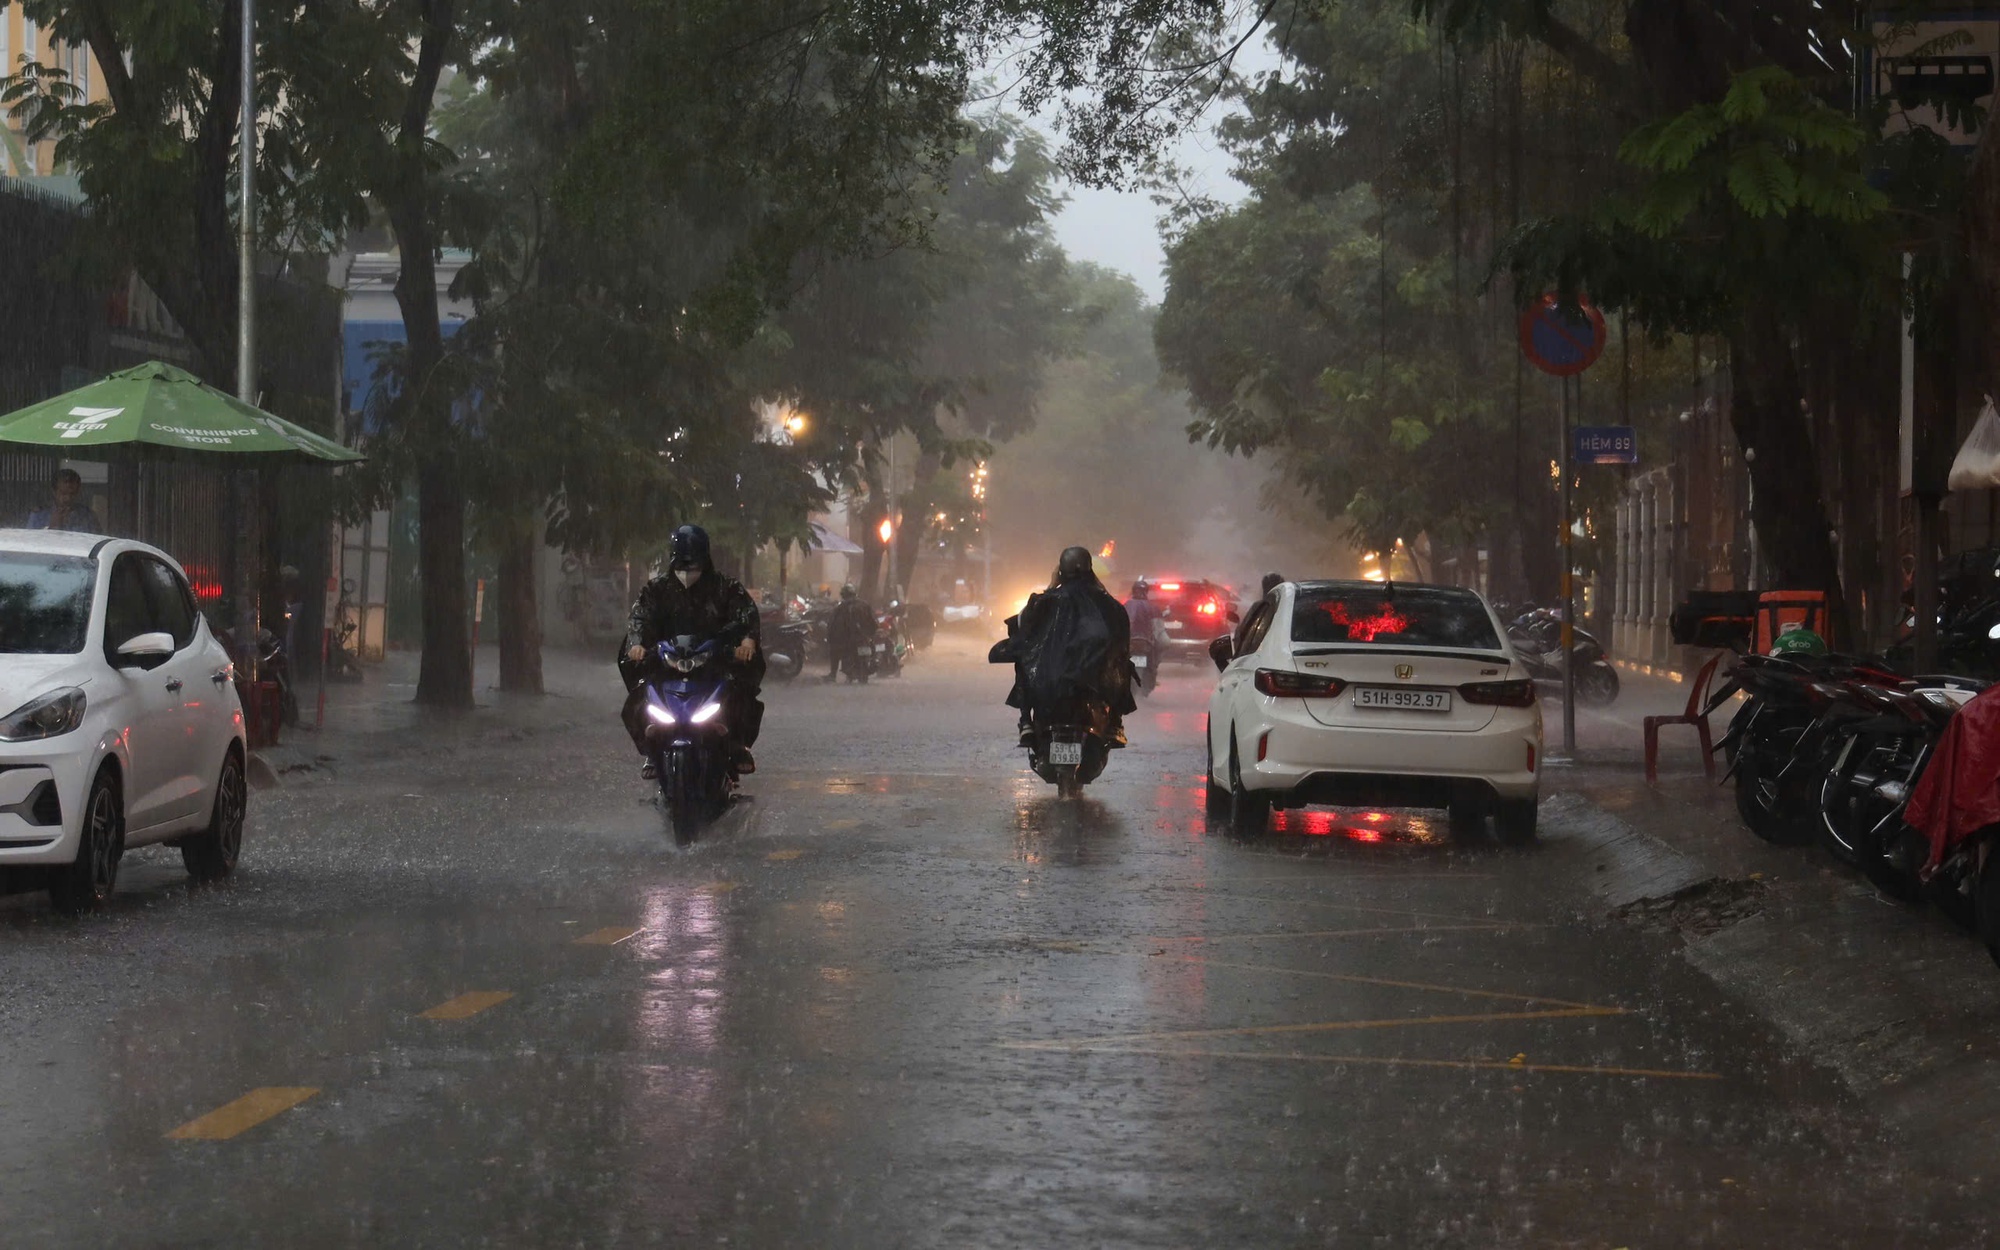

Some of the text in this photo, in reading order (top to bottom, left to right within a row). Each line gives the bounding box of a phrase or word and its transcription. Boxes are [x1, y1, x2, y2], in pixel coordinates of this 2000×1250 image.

[60, 406, 126, 438] 7
[150, 423, 259, 436] CONVENIENCE
[184, 435, 232, 444] STORE
[1615, 437, 1631, 450] 89
[1787, 640, 1811, 649] Grab
[1362, 691, 1443, 708] 51H-992.97
